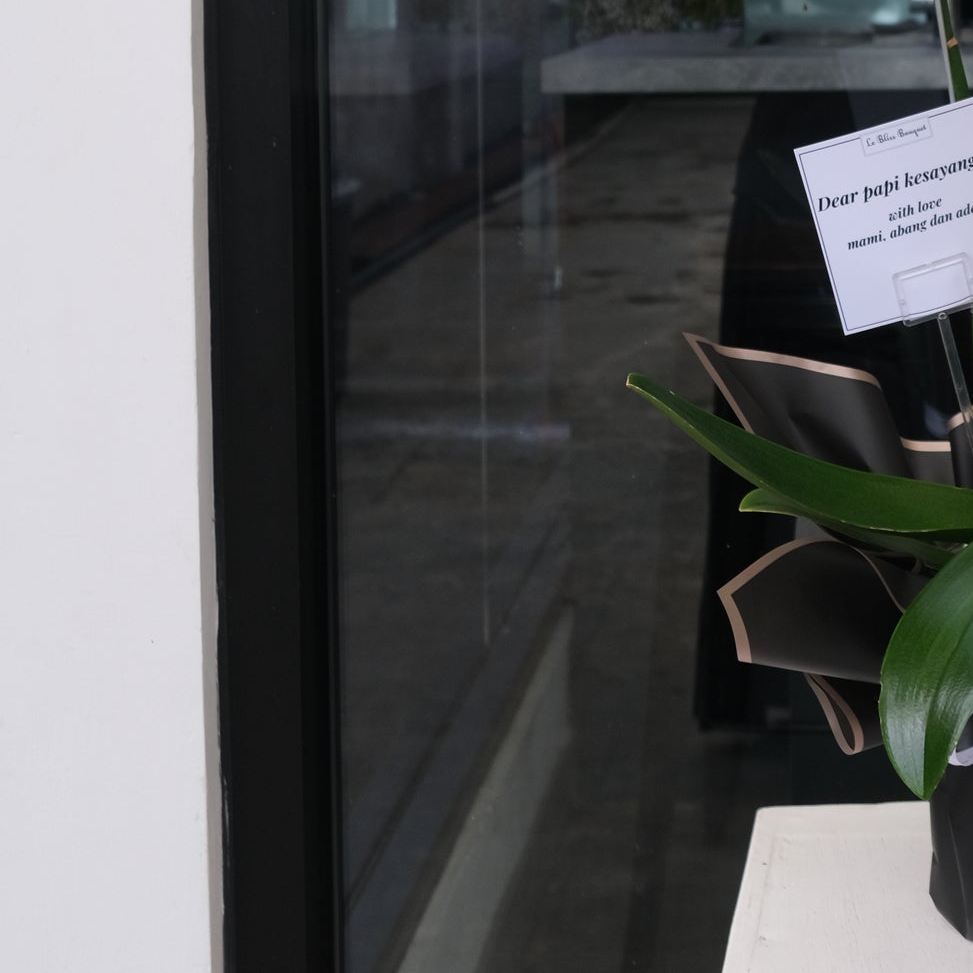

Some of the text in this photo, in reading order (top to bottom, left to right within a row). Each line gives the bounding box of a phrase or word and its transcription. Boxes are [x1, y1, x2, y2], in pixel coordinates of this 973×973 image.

[866, 124, 927, 147] Le Bliss Bouquet
[817, 191, 859, 212] Dear
[862, 176, 900, 203] papi
[888, 198, 943, 222] with love
[889, 221, 928, 240] abang
[929, 212, 954, 227] dan
